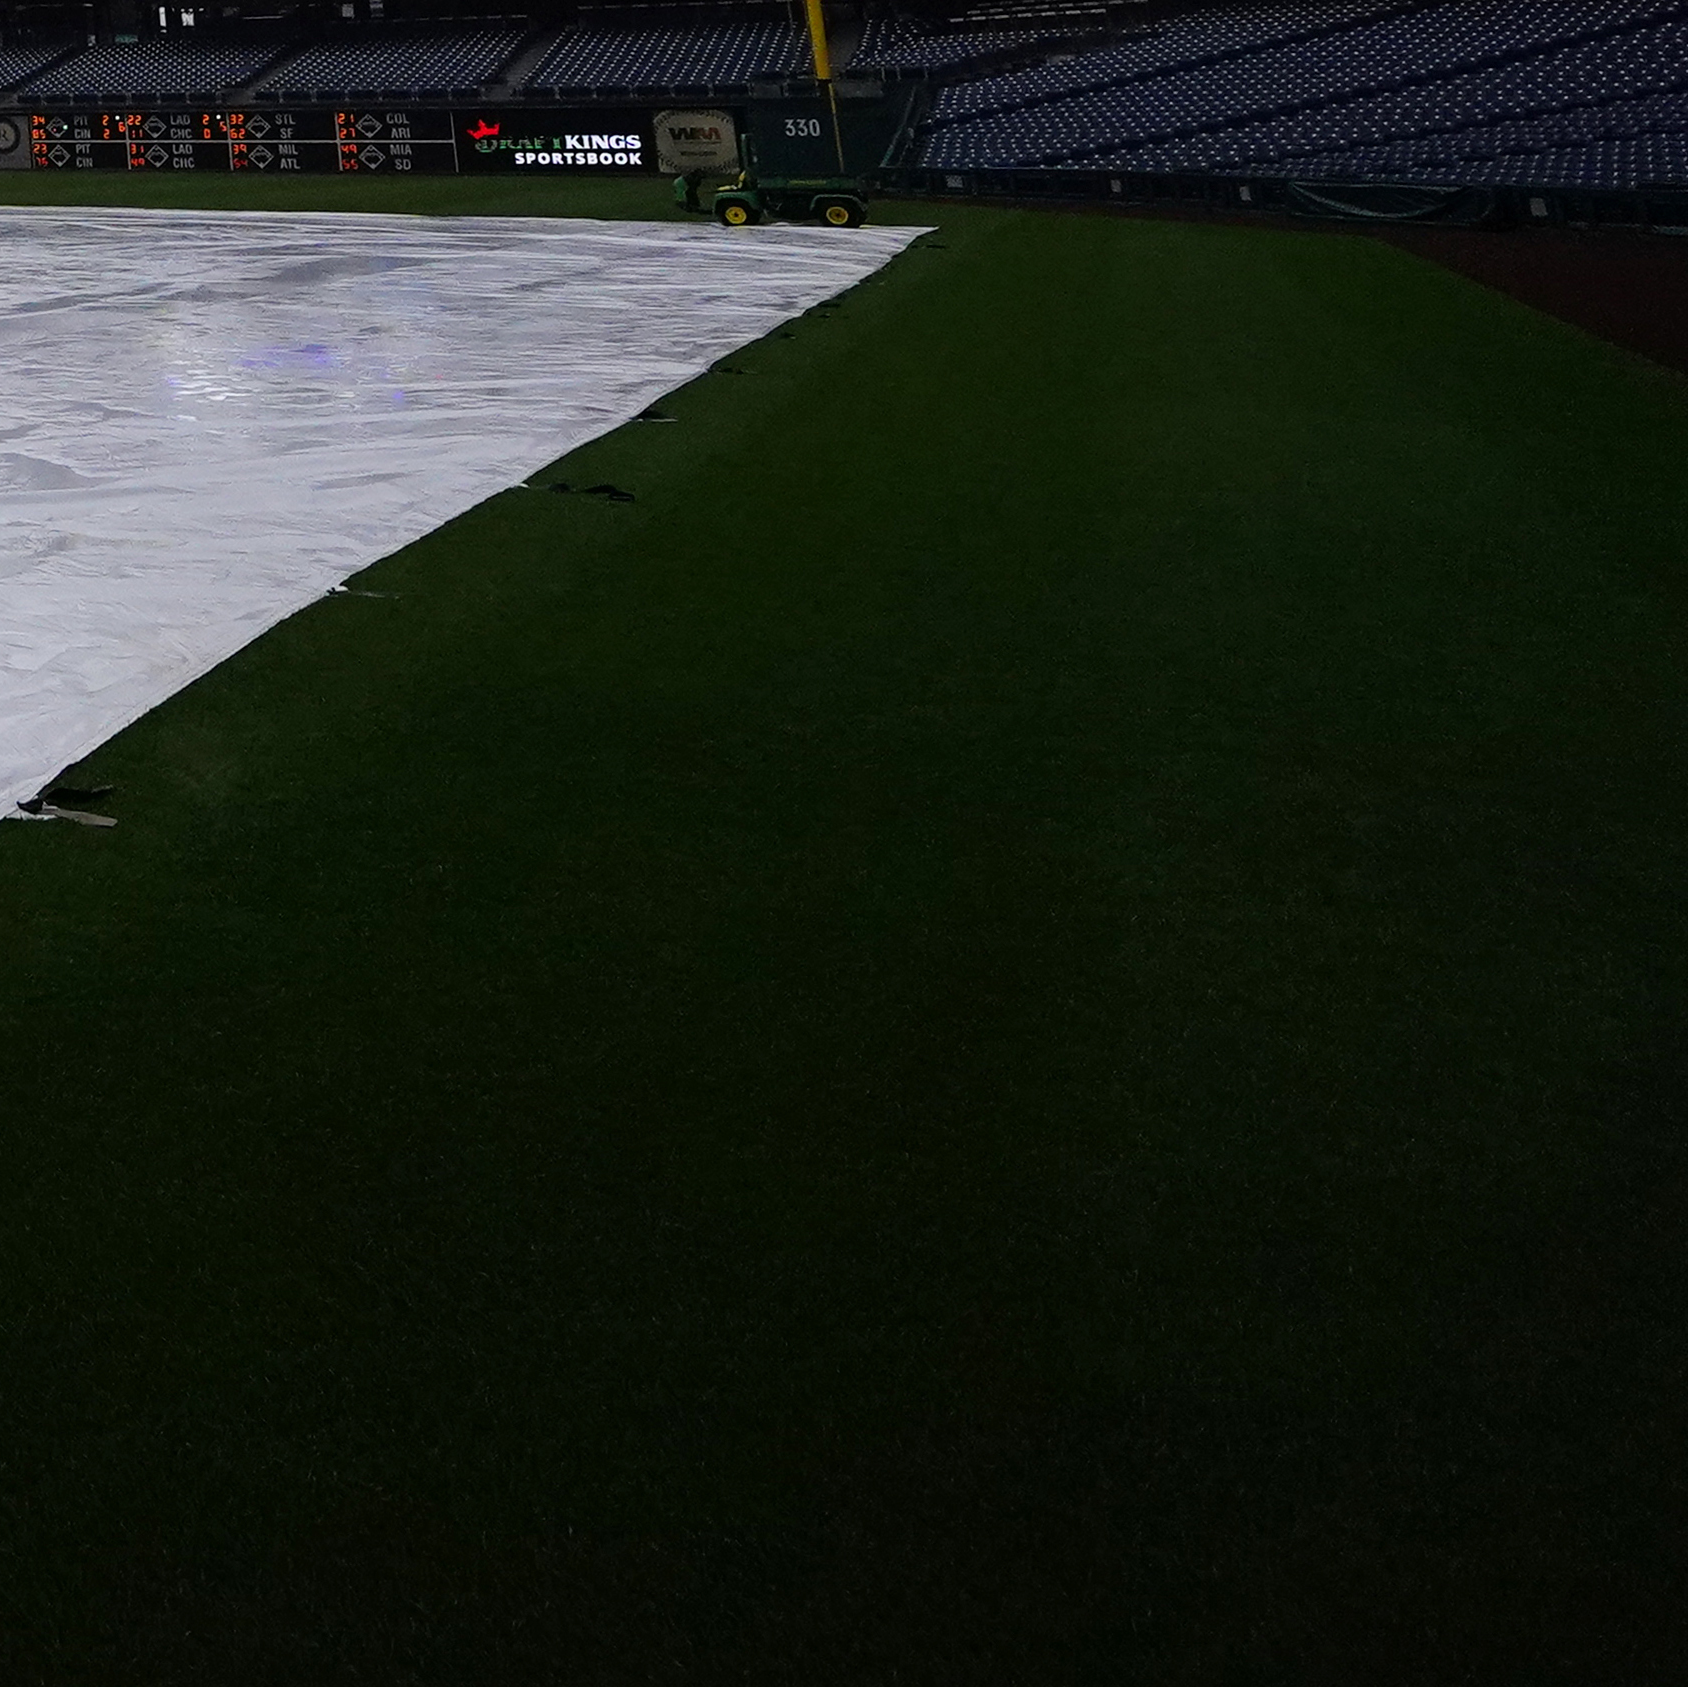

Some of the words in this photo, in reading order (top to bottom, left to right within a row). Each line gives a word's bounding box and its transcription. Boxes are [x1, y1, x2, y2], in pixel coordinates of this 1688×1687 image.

[32, 115, 45, 126] 34
[102, 115, 109, 125] 2
[127, 115, 142, 126] 22
[202, 114, 210, 125] 2
[230, 114, 244, 125] 32
[275, 114, 296, 125] STL
[338, 113, 354, 125] 21
[386, 113, 410, 124] COL
[230, 128, 246, 139] 62
[280, 128, 294, 139] SF
[339, 127, 356, 139] 27
[391, 127, 411, 139] ARI
[784, 118, 821, 138] 330
[103, 129, 110, 140] 2
[170, 129, 192, 140] CHC
[34, 143, 47, 154] 23
[75, 144, 91, 154] PIT
[233, 144, 247, 155] 39
[278, 144, 299, 155] MIL
[341, 144, 357, 155] 49
[390, 144, 413, 156] MIA
[76, 157, 93, 168] CIN
[172, 157, 194, 168] CHC
[280, 157, 300, 169] ATL
[395, 158, 412, 171] SD
[514, 152, 642, 166] SPORTSBOOK
